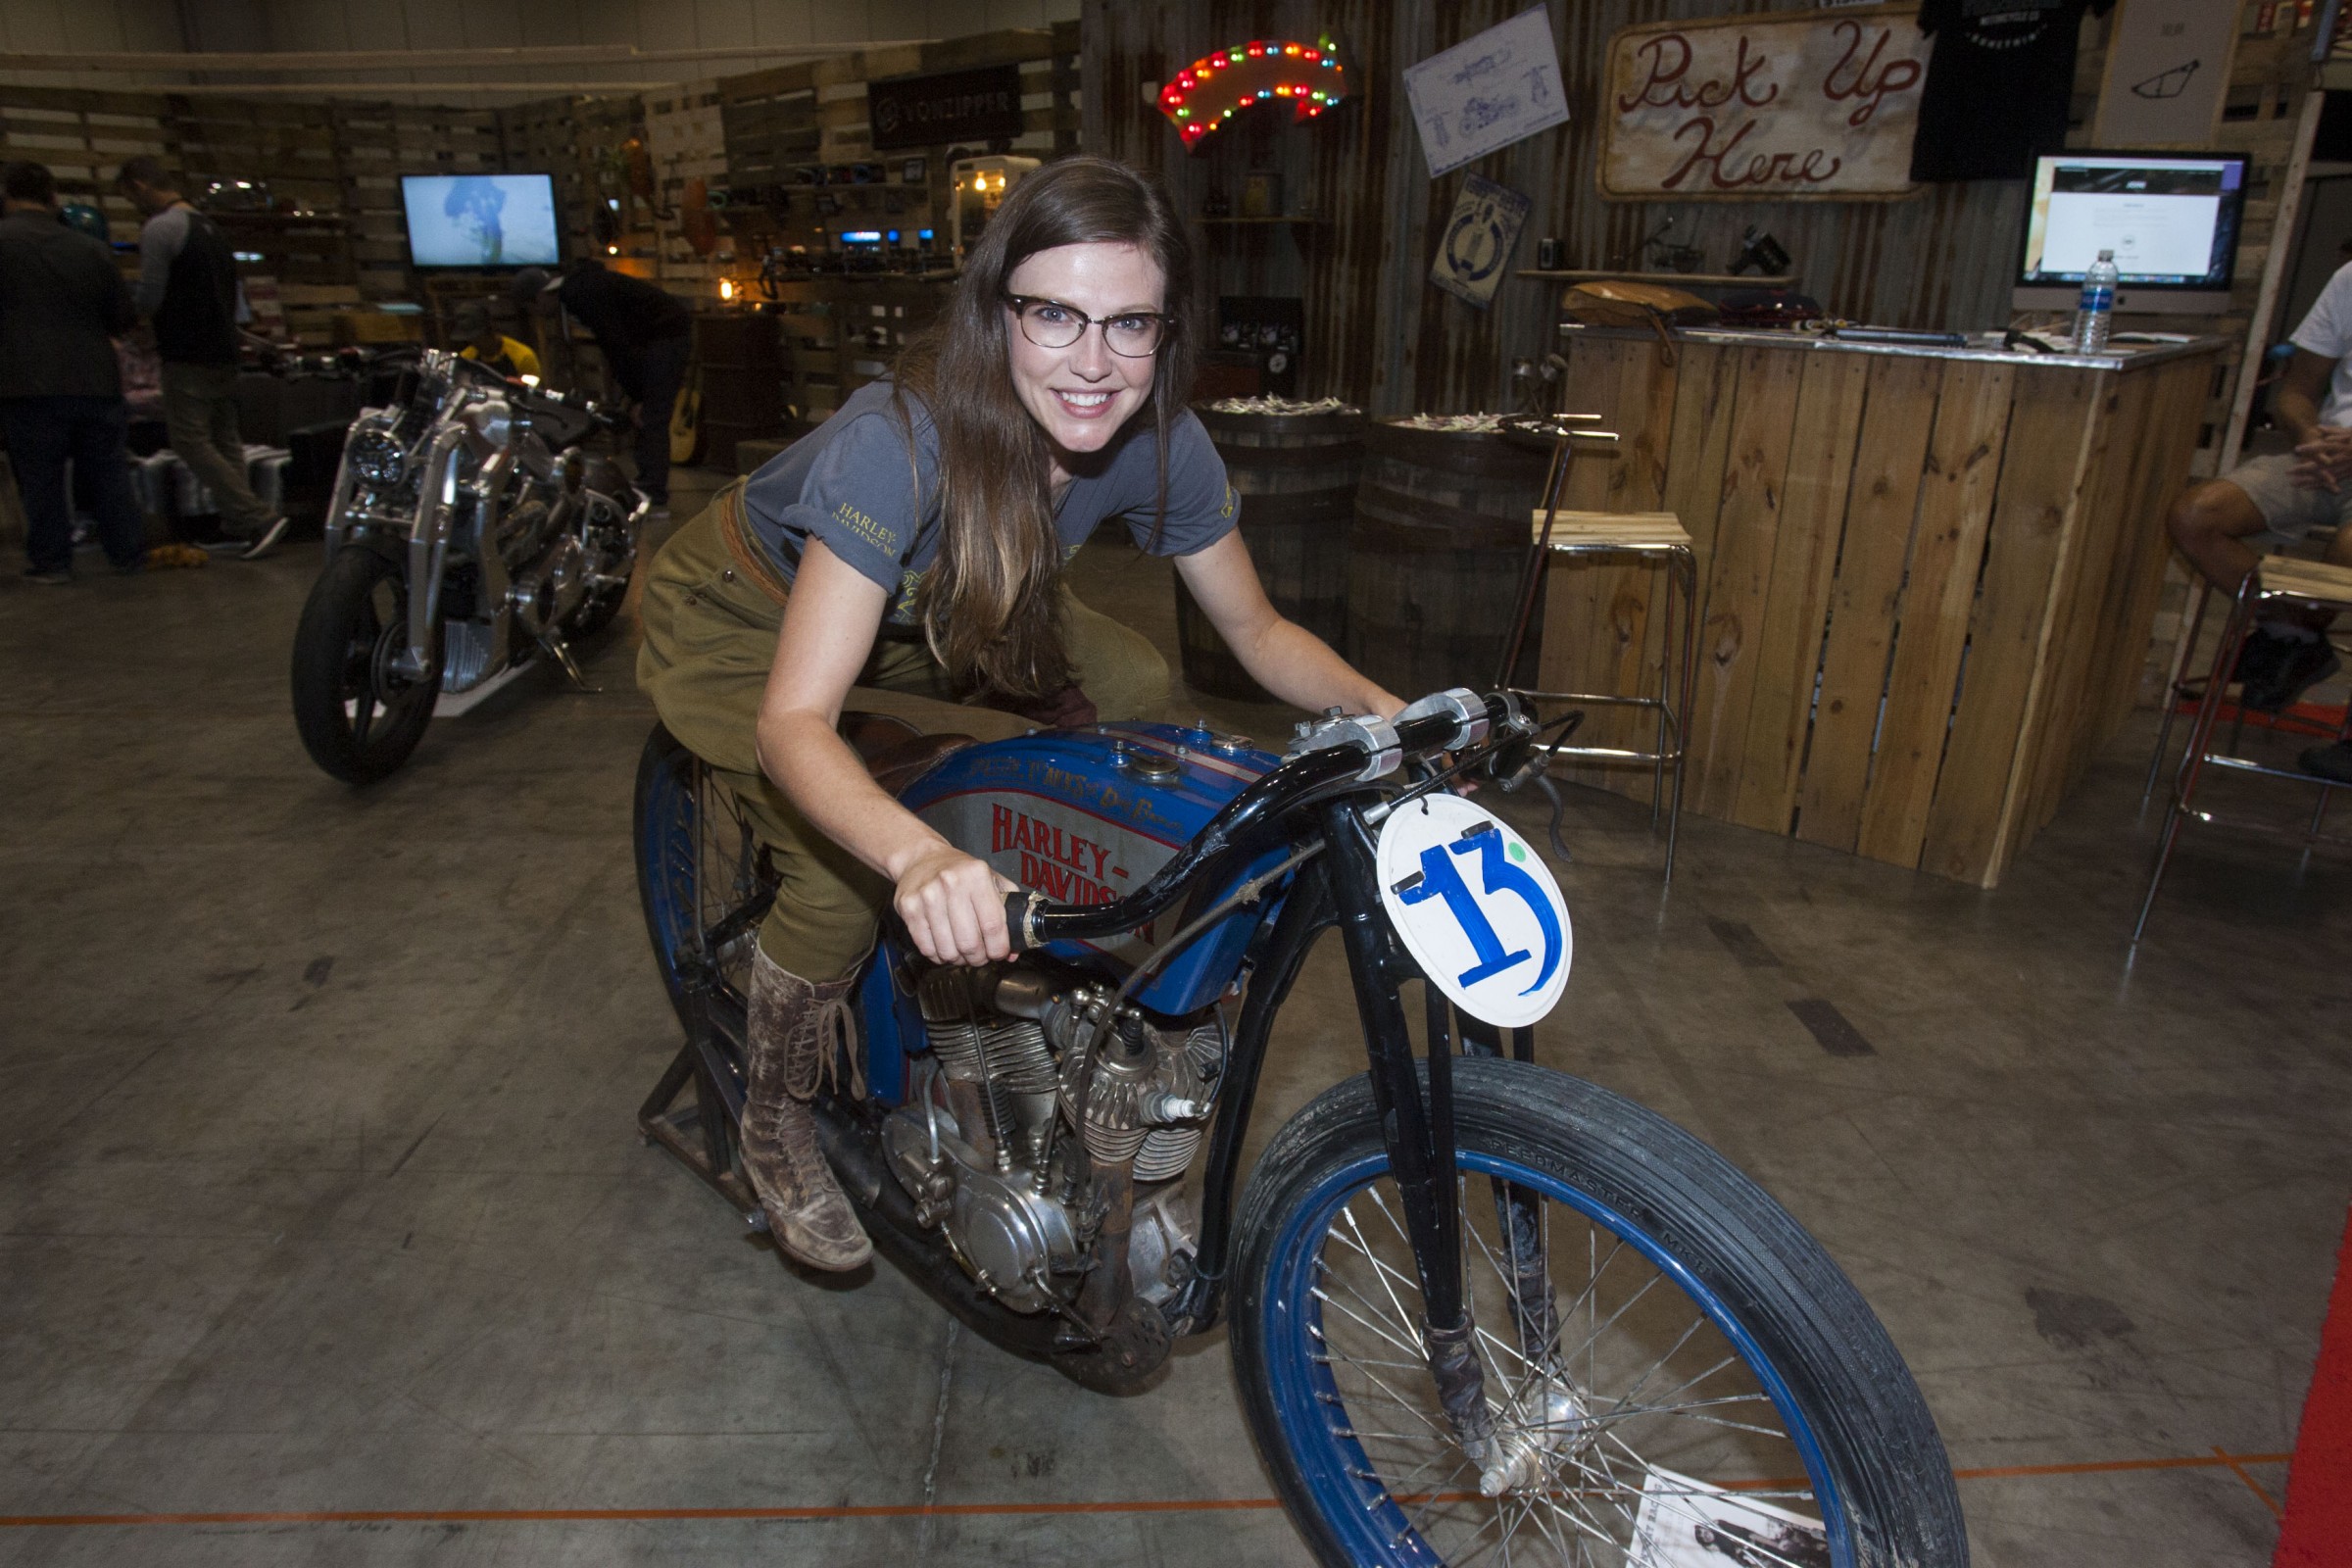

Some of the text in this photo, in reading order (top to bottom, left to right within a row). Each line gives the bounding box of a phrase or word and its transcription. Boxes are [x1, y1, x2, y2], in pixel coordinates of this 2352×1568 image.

[1619, 21, 1921, 126] Pick Up
[1662, 117, 1840, 188] Here
[1399, 827, 1562, 996] 13
